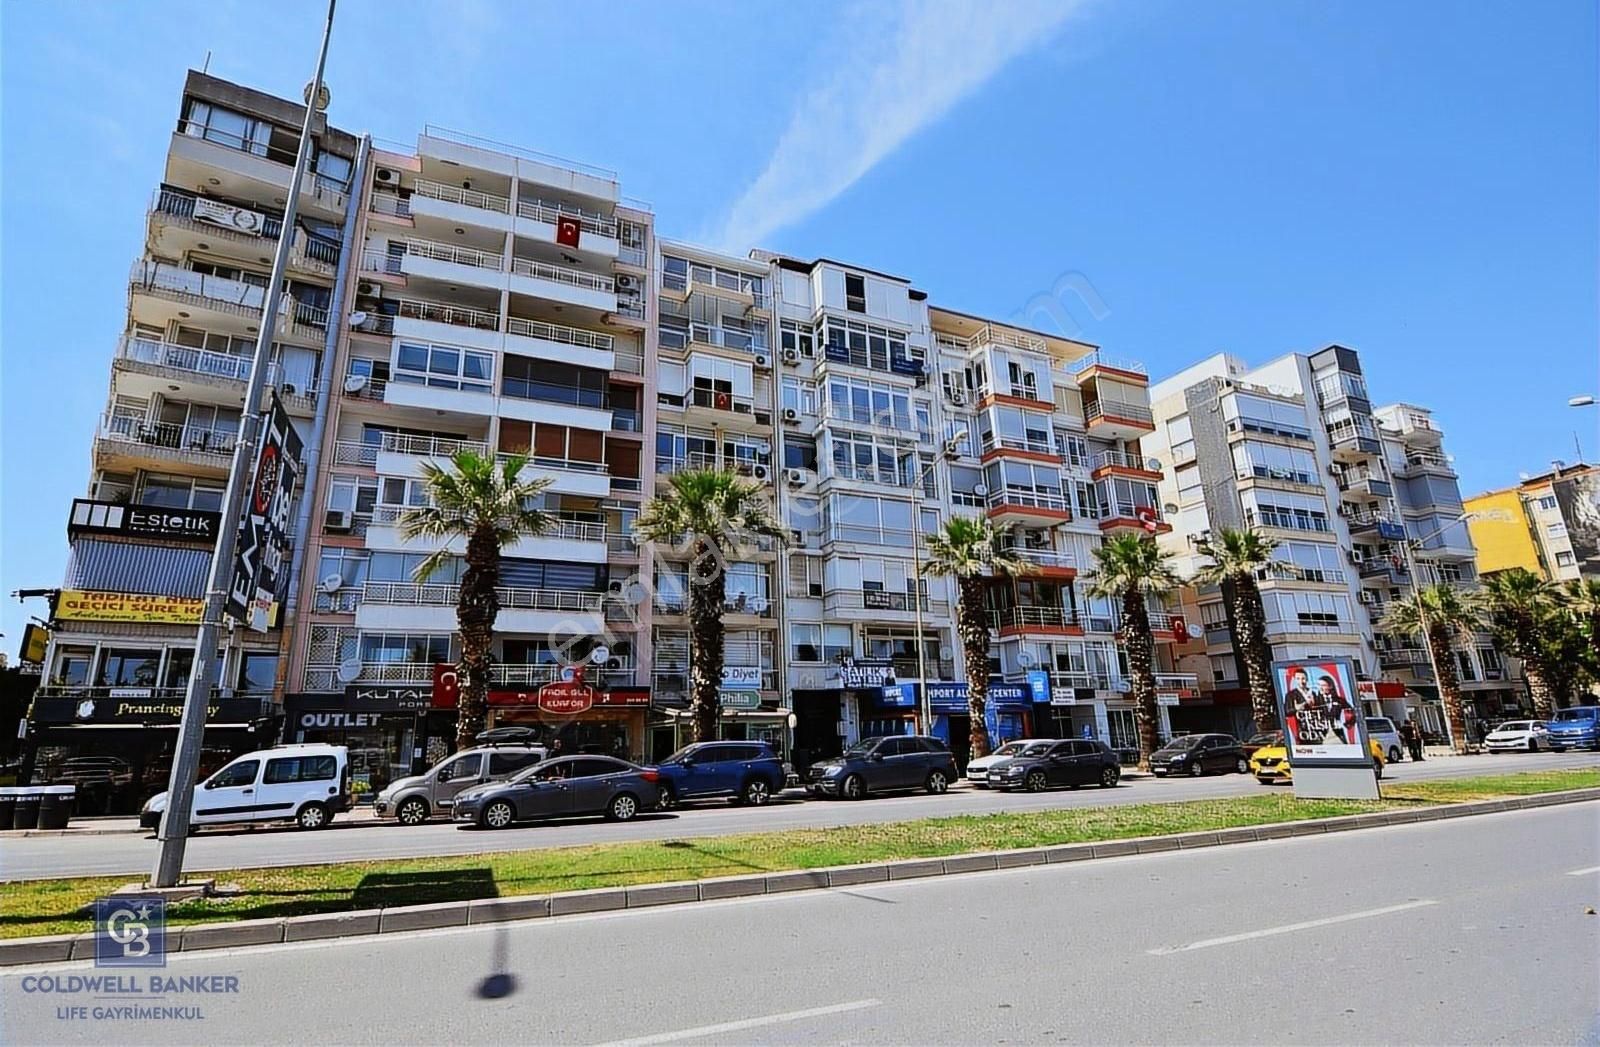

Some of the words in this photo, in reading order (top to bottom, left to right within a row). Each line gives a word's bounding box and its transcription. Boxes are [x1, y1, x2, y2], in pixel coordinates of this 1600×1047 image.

[130, 511, 210, 531] Estetik
[166, 596, 202, 605] NED
[732, 668, 759, 682] Diyet
[356, 690, 433, 699] KUTAH
[928, 688, 954, 699] MPORT
[994, 688, 1023, 699] CENTER
[301, 714, 381, 726] OUTLET
